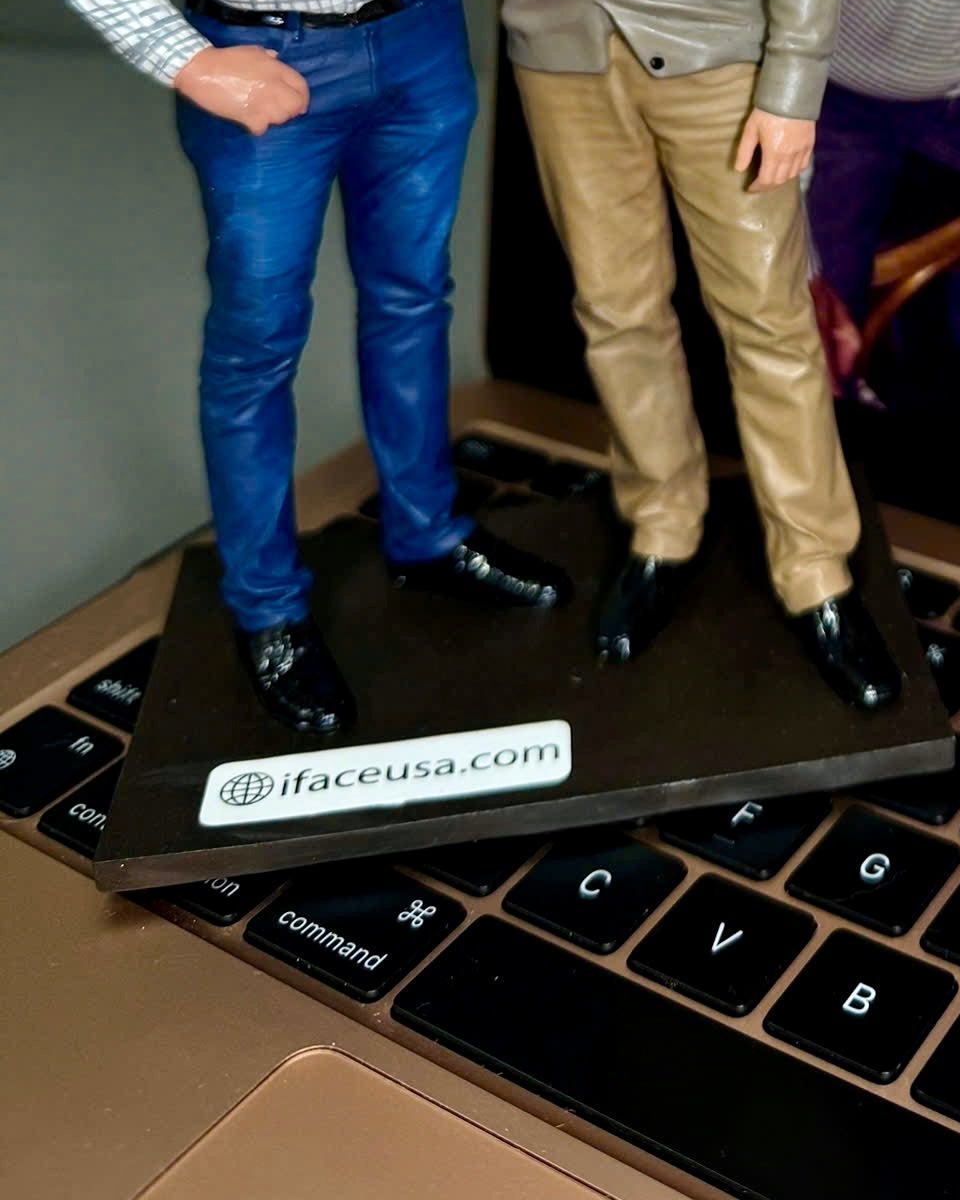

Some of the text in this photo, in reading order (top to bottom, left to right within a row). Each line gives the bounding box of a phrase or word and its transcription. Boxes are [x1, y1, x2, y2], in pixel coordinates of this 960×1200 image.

[97, 679, 141, 704] shift
[69, 736, 94, 756] fn
[280, 743, 560, 797] ifaceusa.com
[731, 801, 763, 827] F
[859, 853, 891, 883] G
[579, 869, 612, 898] C
[278, 910, 389, 971] command
[711, 921, 744, 954] V
[842, 982, 877, 1016] B
